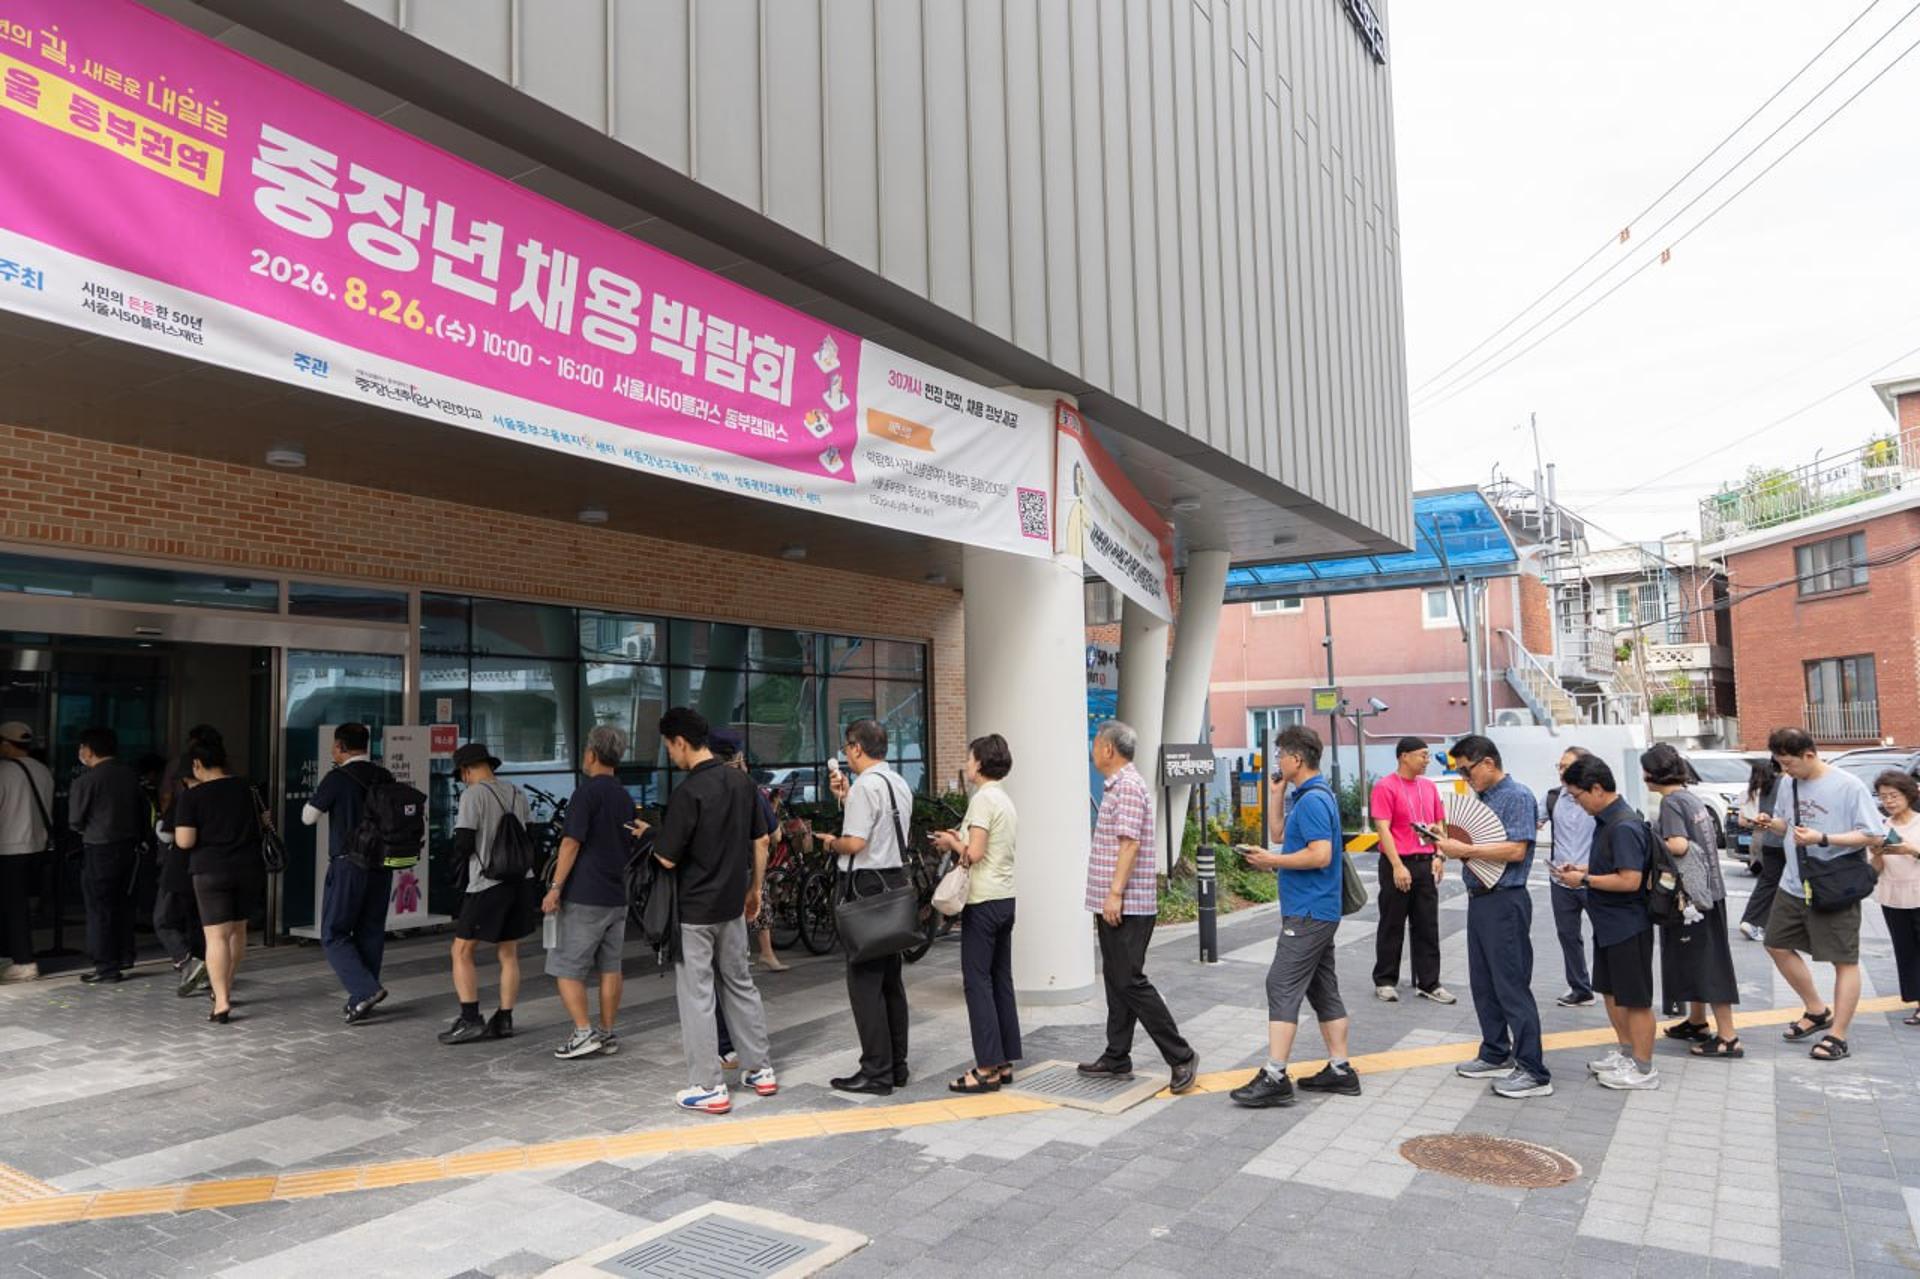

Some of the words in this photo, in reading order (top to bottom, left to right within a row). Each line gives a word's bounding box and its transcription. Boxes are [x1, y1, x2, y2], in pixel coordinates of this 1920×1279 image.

[40, 27, 77, 73] 길,
[82, 59, 142, 100] 새로운
[147, 78, 229, 138] 내일로
[68, 92, 210, 182] 동부권역
[0, 257, 44, 291] 주최
[81, 280, 124, 306] 시민의
[172, 310, 203, 332] 50년
[81, 296, 204, 346] 서울시50플러스재단
[293, 352, 329, 379] 주관
[482, 329, 533, 367] 10:00
[556, 355, 604, 388] 16:00
[613, 373, 722, 426] 서울시50플러스
[724, 407, 789, 443] 동부캠퍼스
[888, 369, 922, 397] 30개사
